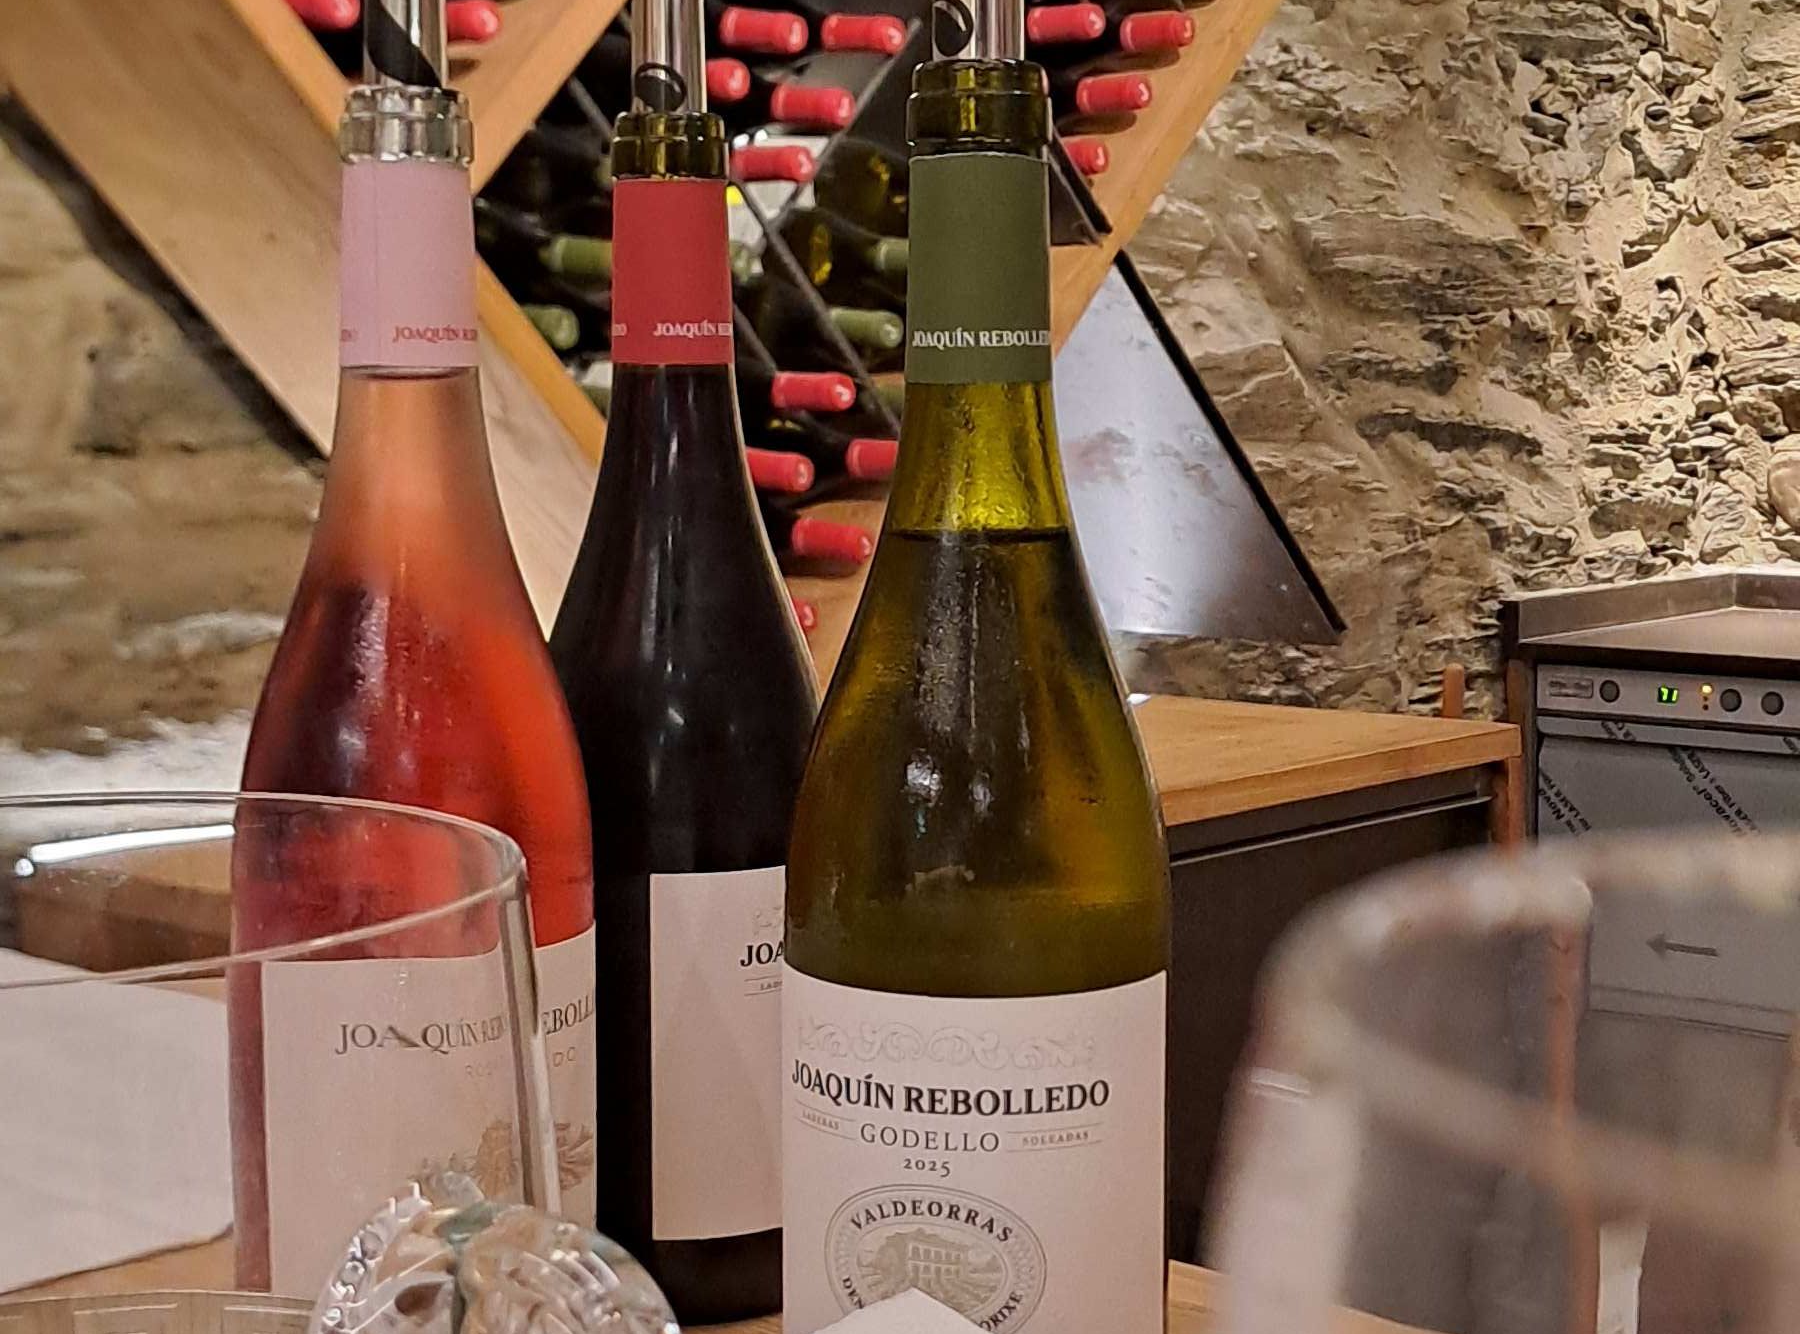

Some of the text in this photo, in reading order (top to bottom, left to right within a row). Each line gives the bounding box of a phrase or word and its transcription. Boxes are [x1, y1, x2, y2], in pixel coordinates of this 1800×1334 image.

[912, 326, 976, 351] JOAQUÍN
[792, 1058, 1110, 1116] JOAQUÍN REBOLLEDO
[860, 1123, 1000, 1152] GODELLO
[1022, 1130, 1089, 1146] SOLEADAS
[903, 1157, 951, 1178] 2025
[850, 1199, 1013, 1242] VALDEORRAS
